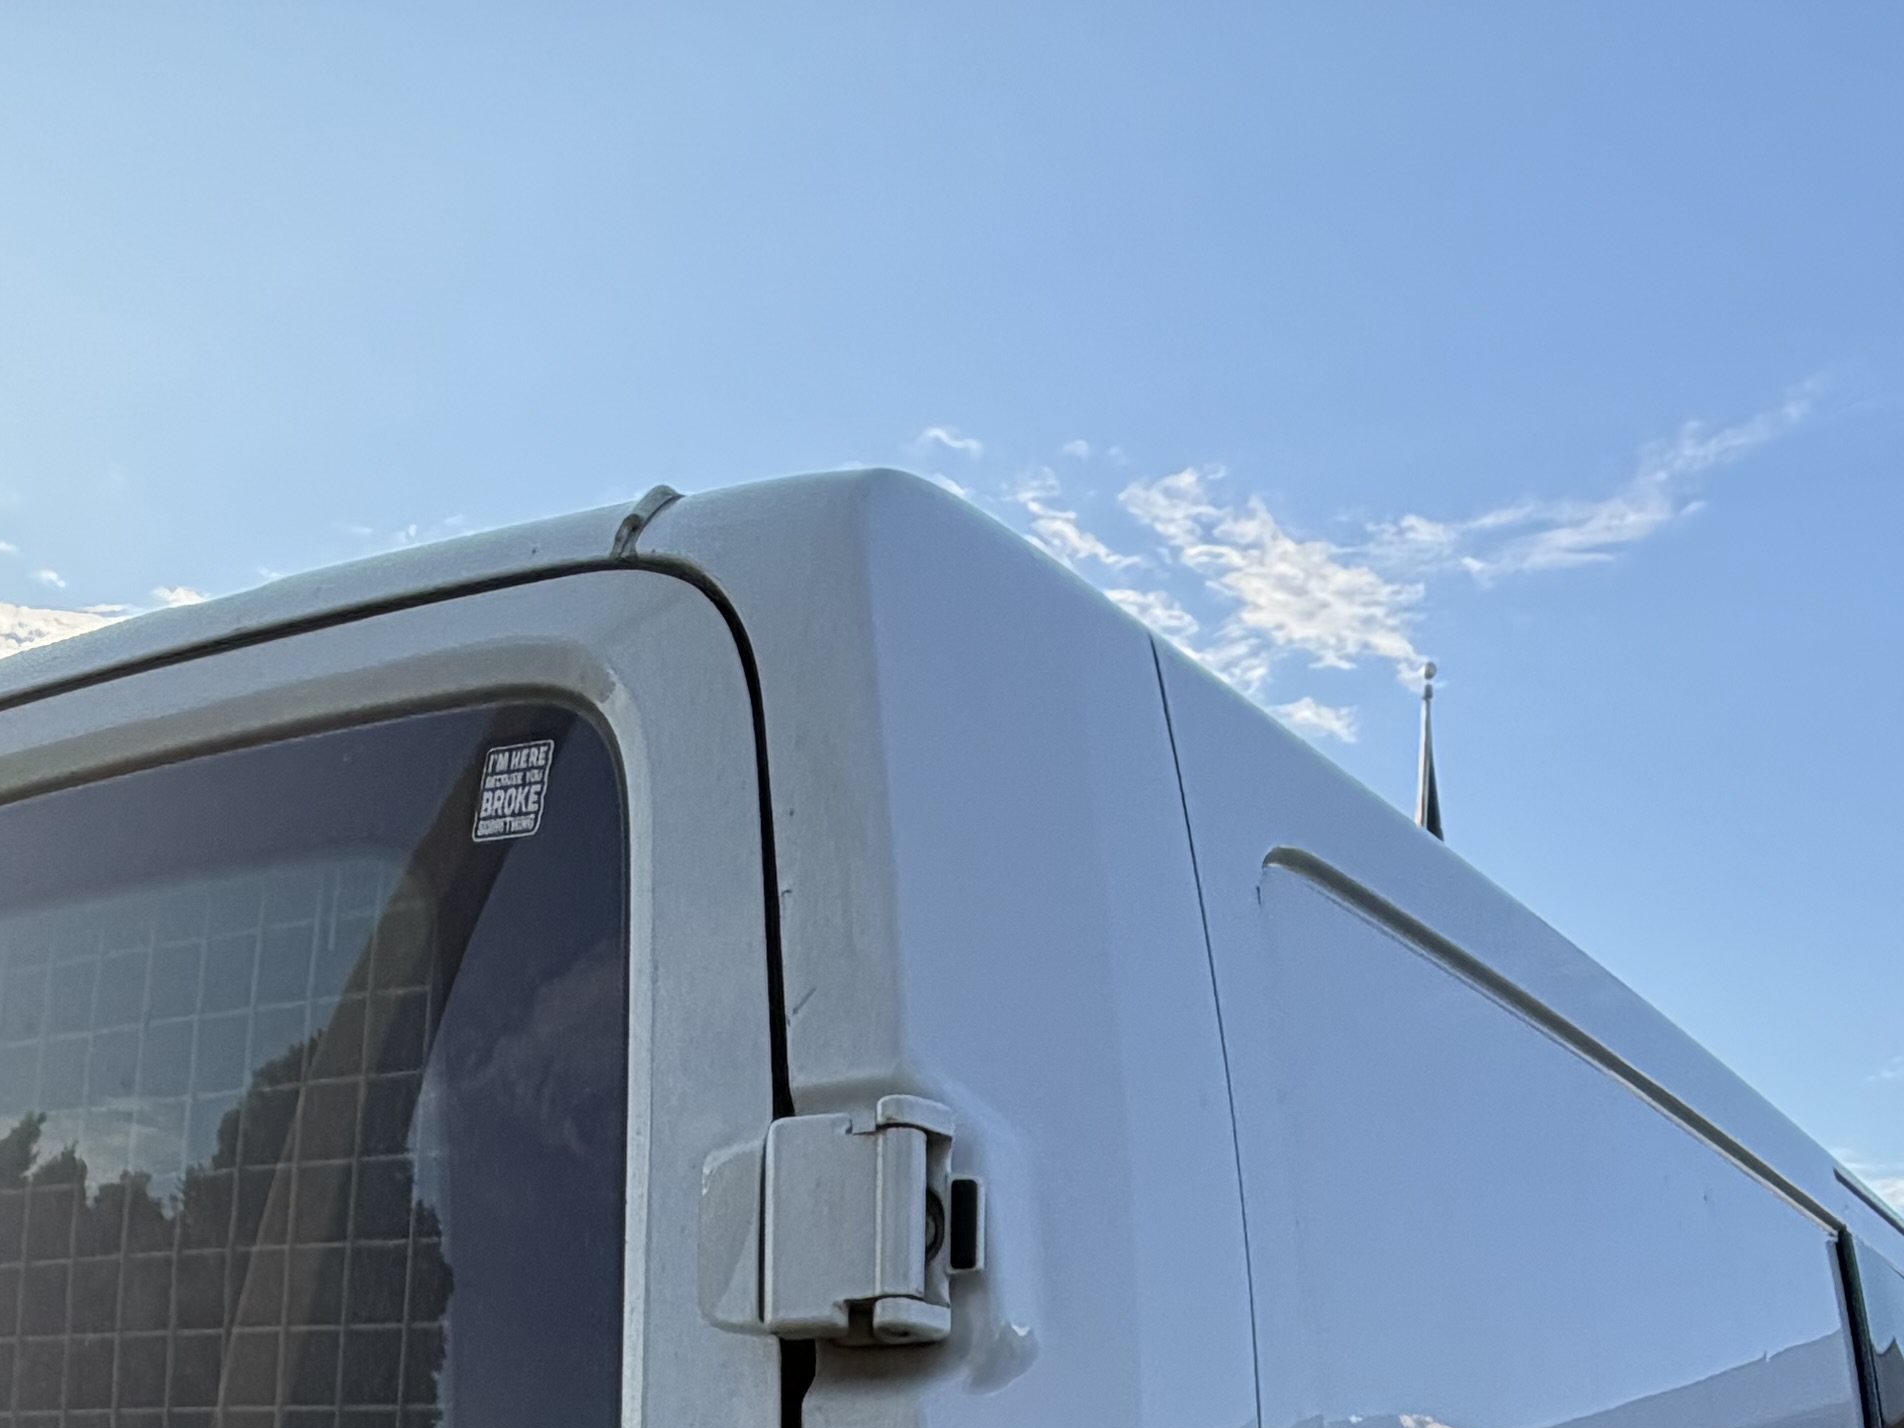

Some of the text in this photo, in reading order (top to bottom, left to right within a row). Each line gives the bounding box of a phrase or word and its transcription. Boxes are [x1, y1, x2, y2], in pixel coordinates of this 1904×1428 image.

[488, 746, 548, 773] I'M HERE
[480, 784, 541, 818] BROKE
